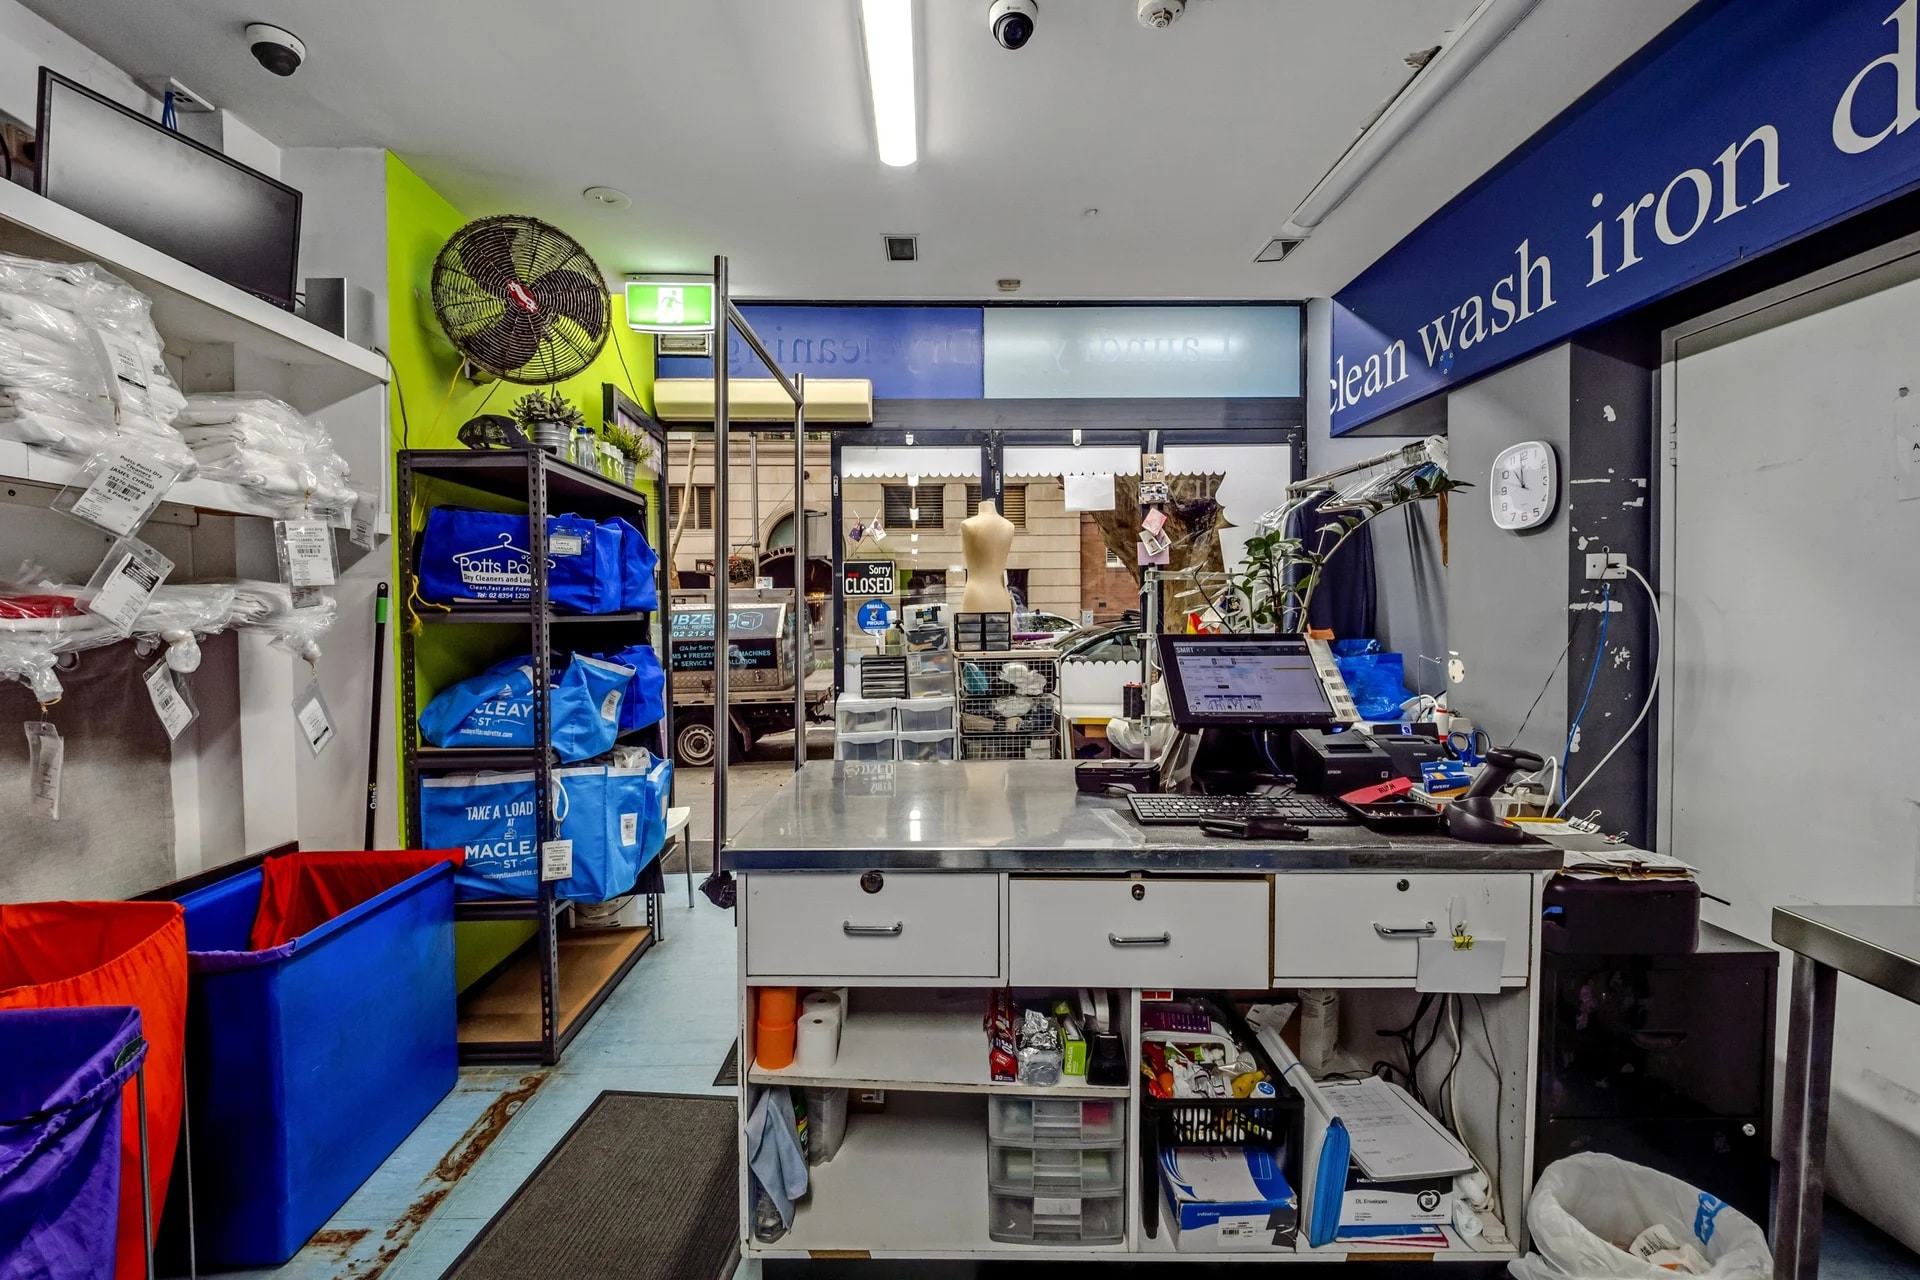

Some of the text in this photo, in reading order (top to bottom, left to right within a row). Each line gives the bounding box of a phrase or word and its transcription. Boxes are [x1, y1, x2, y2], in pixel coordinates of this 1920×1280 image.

[1418, 238, 1557, 368] wash
[1585, 124, 1790, 288] iron
[1501, 486, 1507, 496] 9
[1501, 502, 1508, 512] 8
[1532, 507, 1540, 517] 5
[1510, 512, 1516, 522] 7
[1521, 512, 1528, 521] 6
[460, 556, 501, 573] Potts
[868, 564, 891, 577] Sorry
[463, 573, 474, 582] Dry
[475, 574, 504, 583] Cleaners
[845, 577, 893, 594] CLOSED
[477, 717, 492, 726] ST
[465, 801, 533, 820] TAKE A LOAD
[507, 818, 515, 827] AT
[503, 859, 518, 868] ST
